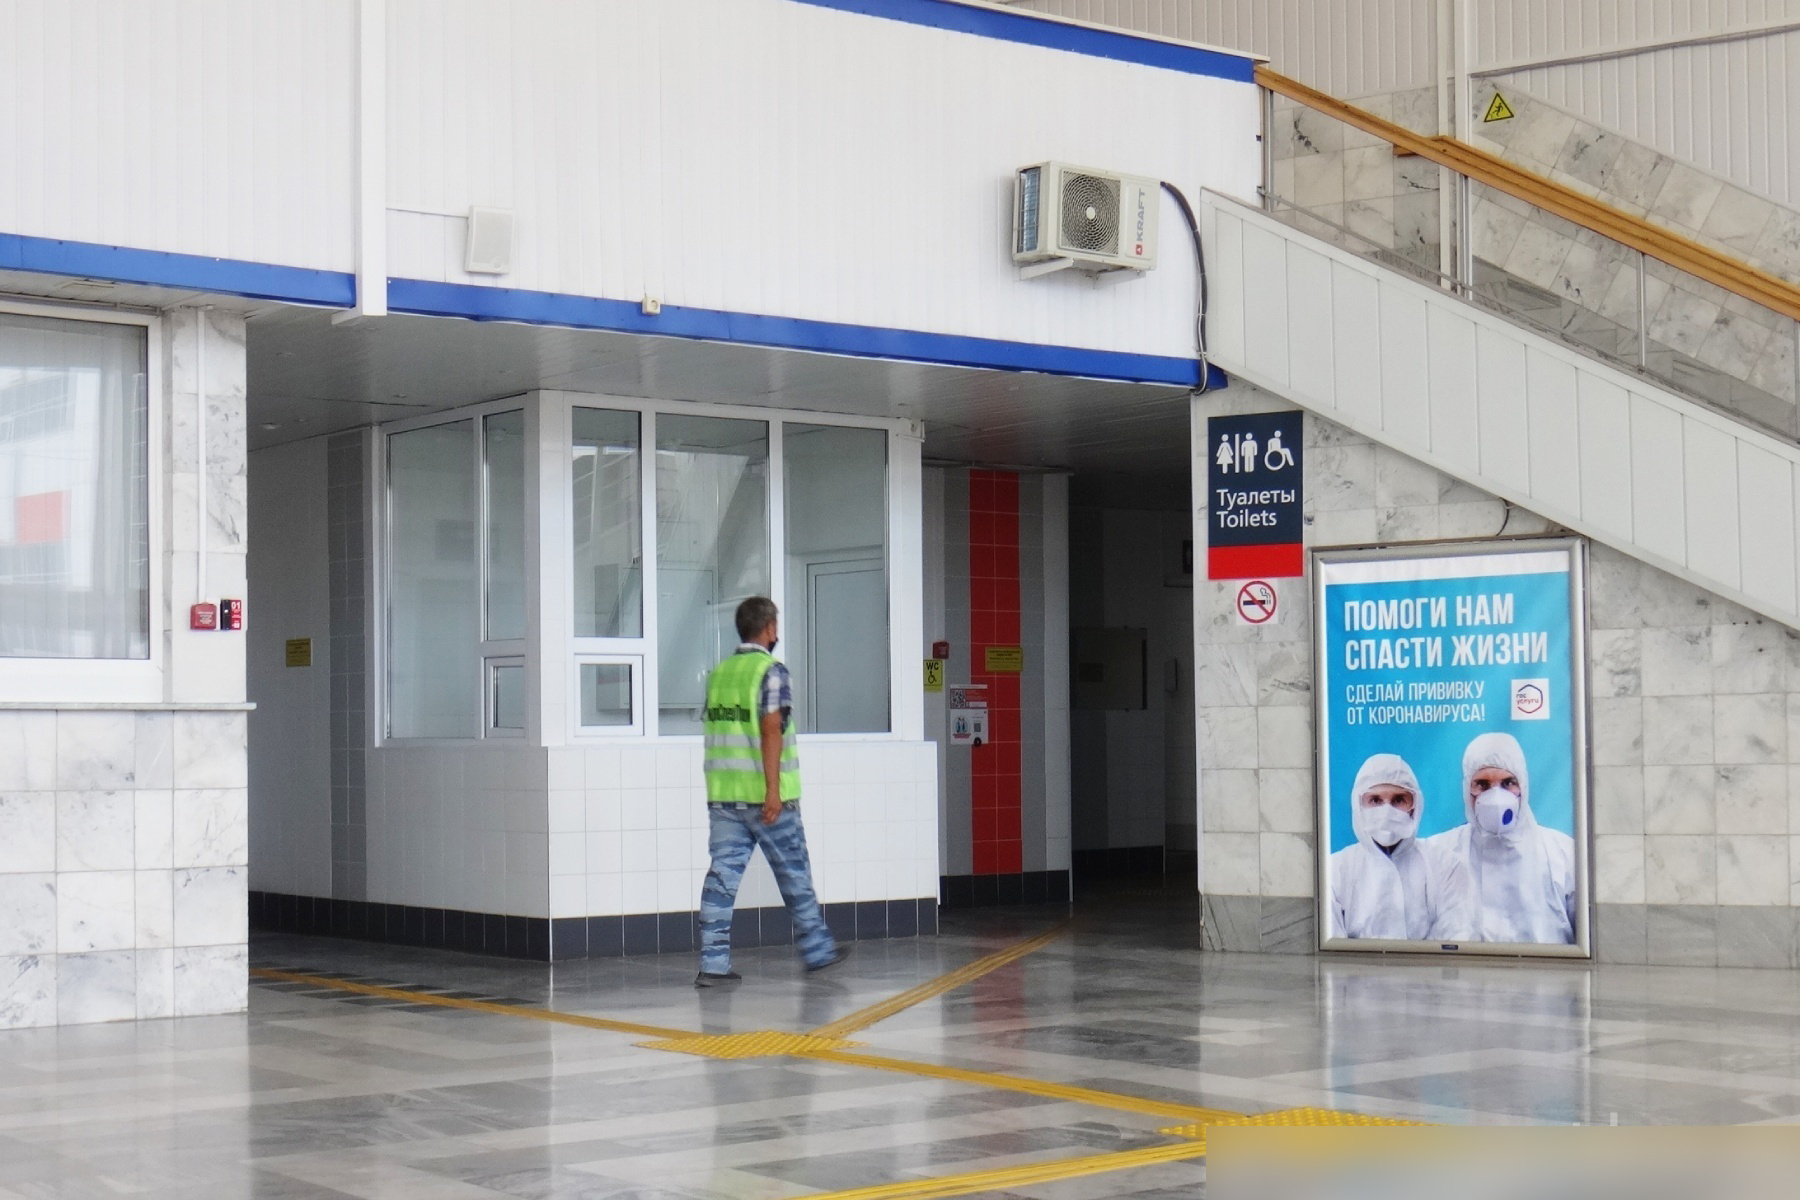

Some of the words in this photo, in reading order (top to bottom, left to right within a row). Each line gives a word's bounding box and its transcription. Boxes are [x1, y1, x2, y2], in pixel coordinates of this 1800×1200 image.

[1136, 188, 1146, 241] KRAFT
[1216, 489, 1295, 511] Туалеты
[1216, 508, 1277, 528] Toilets
[1344, 597, 1447, 631] ПОМОГИ
[1456, 593, 1514, 626] НАМ
[1345, 636, 1443, 670] СПАСТИ
[1451, 632, 1548, 666] ЖИЗНИ
[926, 661, 939, 671] WC
[1346, 680, 1404, 704] СДЕЛАЙ
[1408, 680, 1485, 701] ПРИВИВКУ
[1347, 706, 1364, 725] ОТ
[1369, 703, 1486, 725] КОРОНАВИРУСА!
